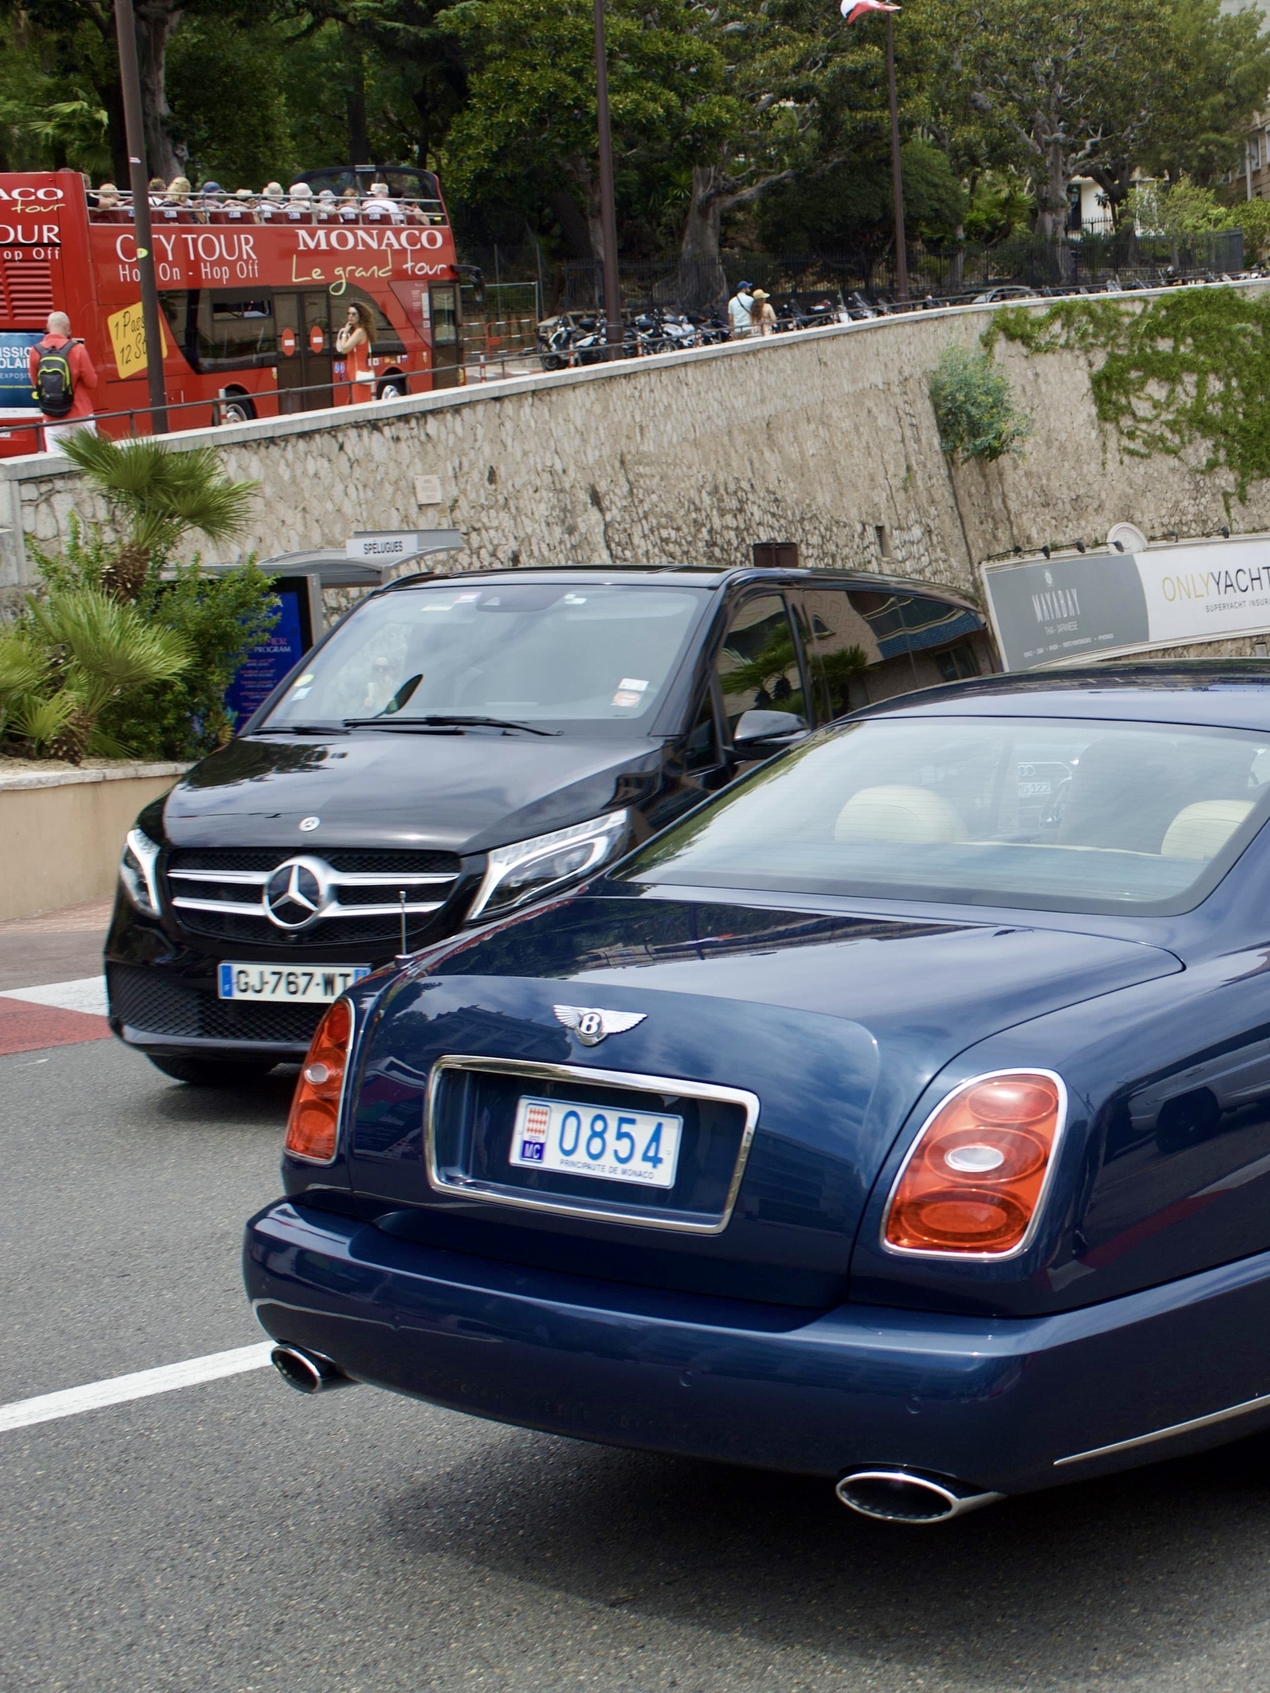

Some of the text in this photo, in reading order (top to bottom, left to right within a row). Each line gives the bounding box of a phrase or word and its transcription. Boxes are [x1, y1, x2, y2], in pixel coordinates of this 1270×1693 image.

[11, 200, 66, 214] tour
[0, 224, 61, 244] OUR
[295, 229, 443, 250] MONACO
[32, 247, 60, 260] Off
[116, 233, 258, 262] CY TOUR
[118, 264, 141, 282] Ho
[158, 262, 181, 281] On
[200, 262, 230, 284] Hop
[236, 260, 259, 279] Off
[291, 248, 448, 296] Le grand tour
[119, 344, 132, 366] 12
[1205, 600, 1247, 613] SUPERYACHT
[523, 1110, 663, 1168] MC 0854
[560, 1159, 654, 1179] PRINCIPAUTE DE MONACO
